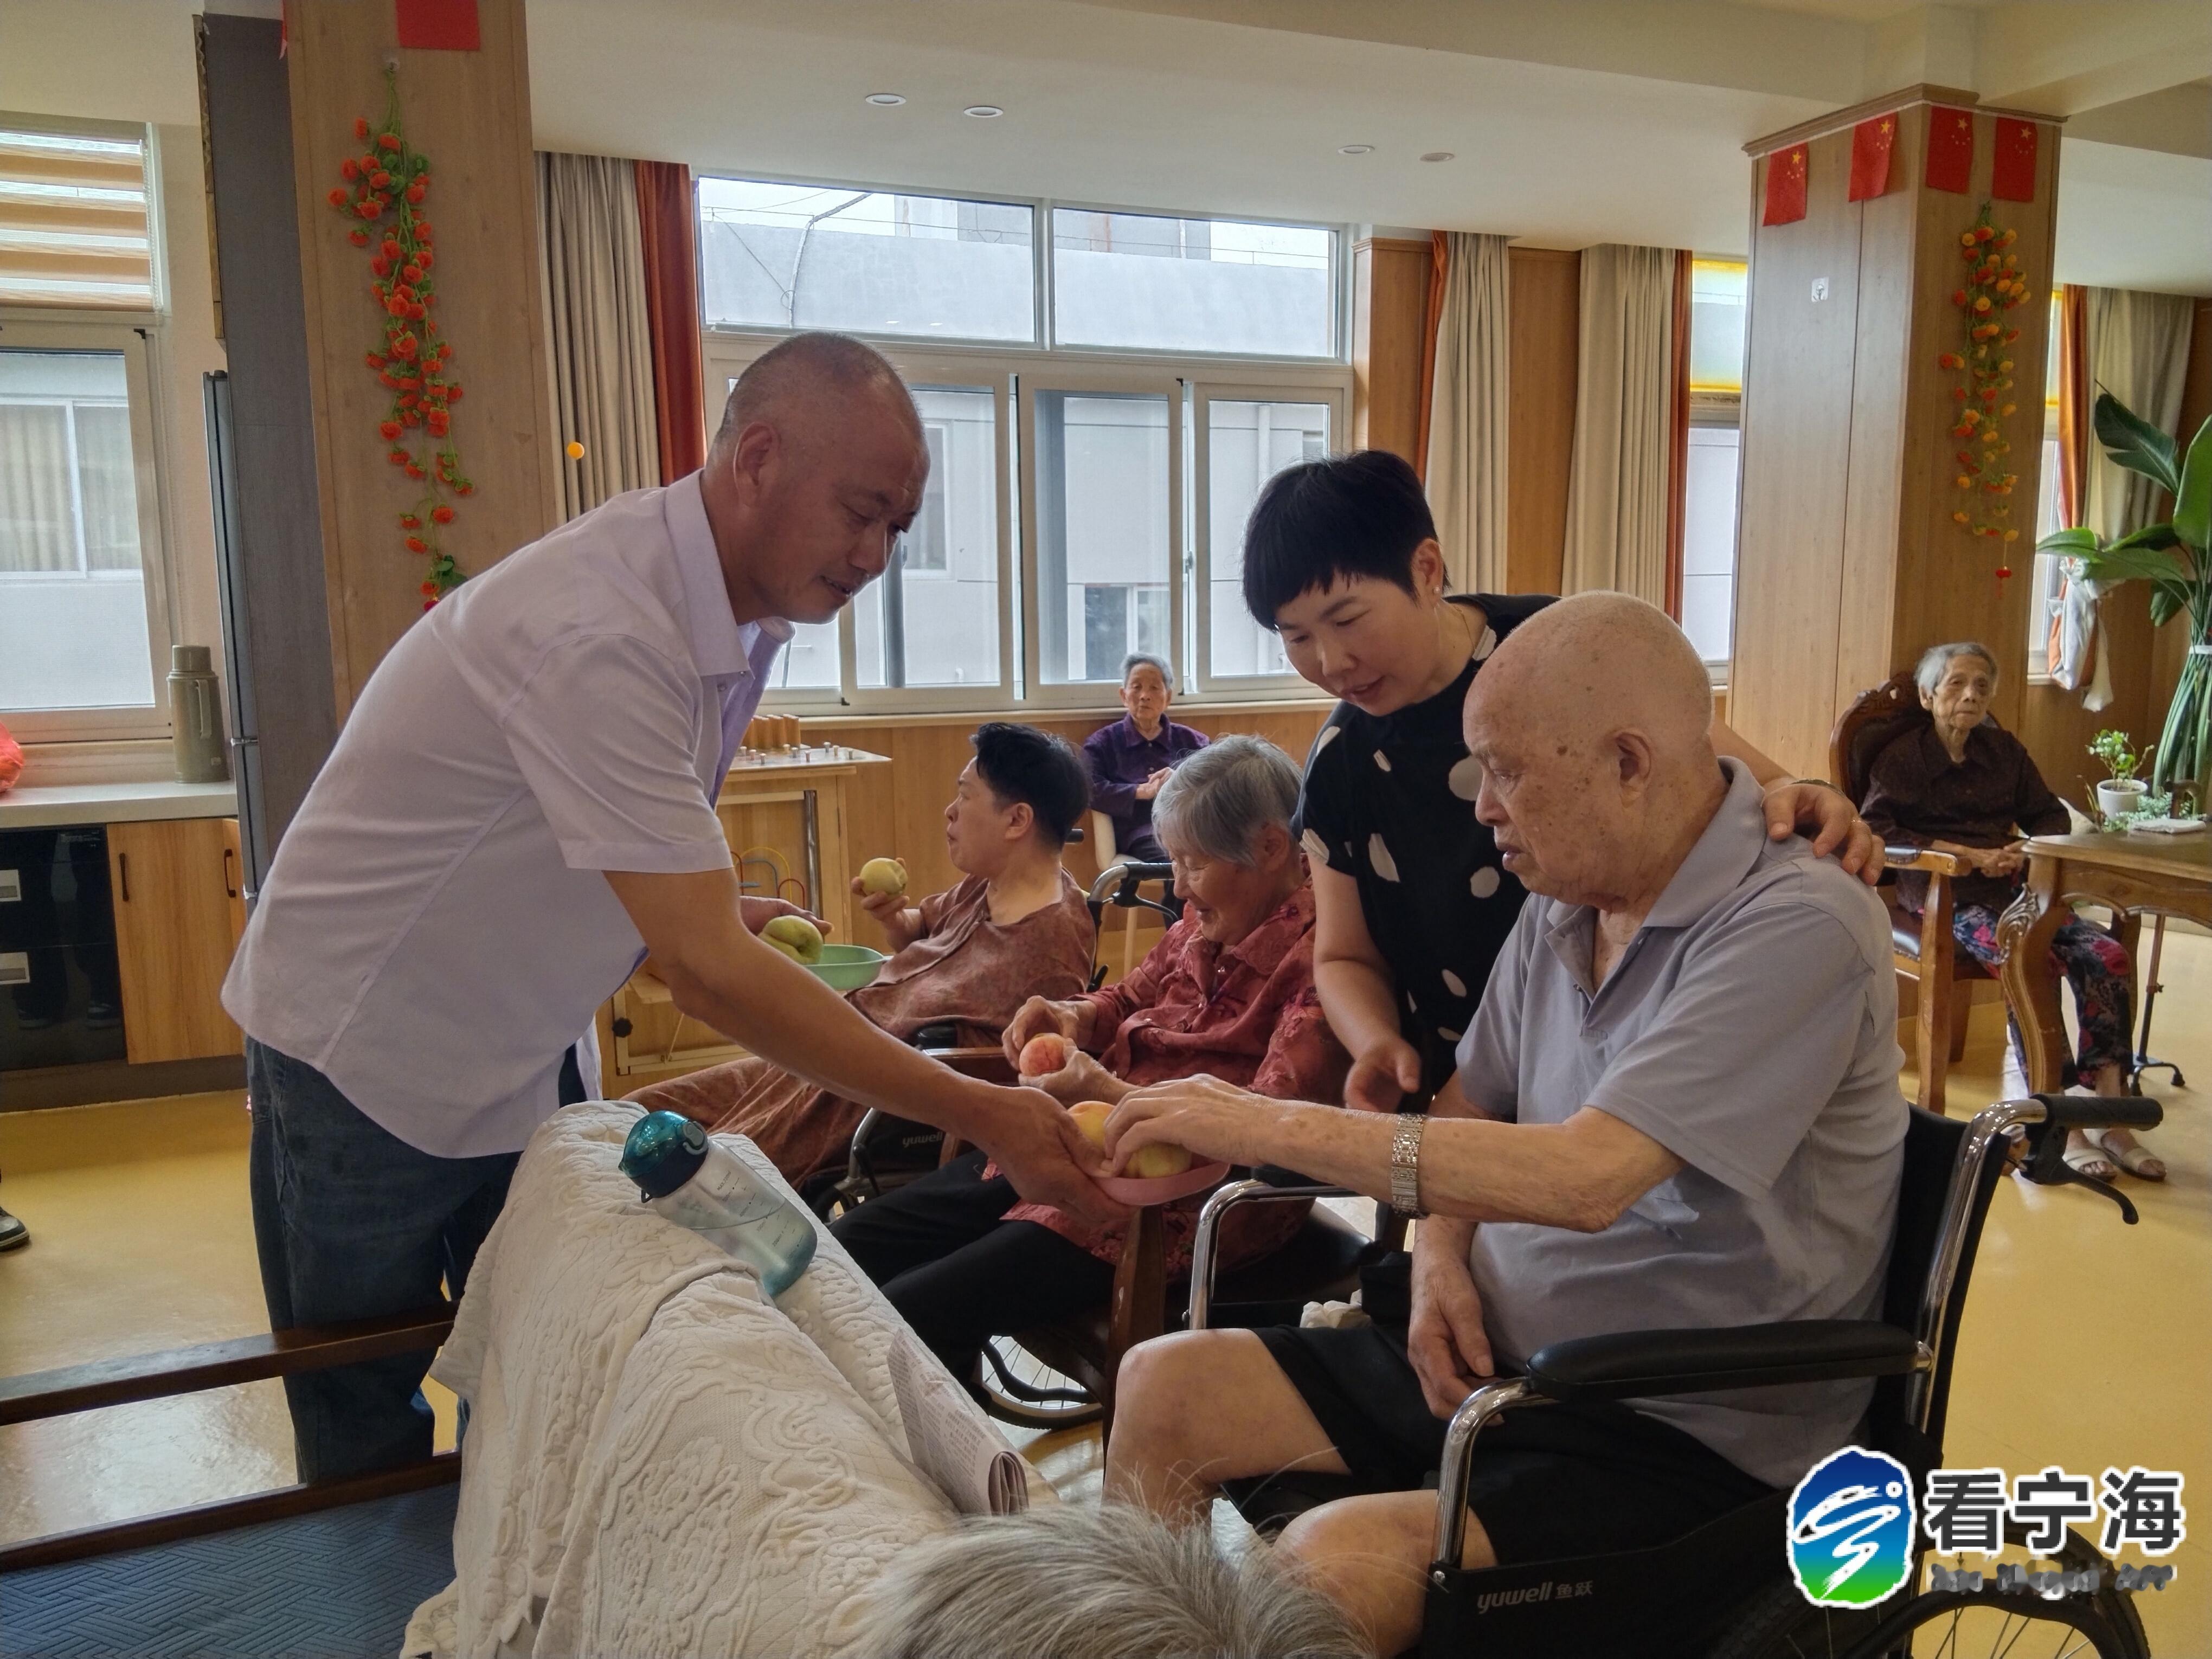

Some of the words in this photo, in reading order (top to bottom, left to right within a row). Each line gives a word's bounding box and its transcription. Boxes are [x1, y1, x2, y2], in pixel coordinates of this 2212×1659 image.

[902, 1131, 943, 1148] yuwell
[1477, 1581, 1553, 1615] yuwell
[1555, 1580, 1594, 1599] 鱼跃
